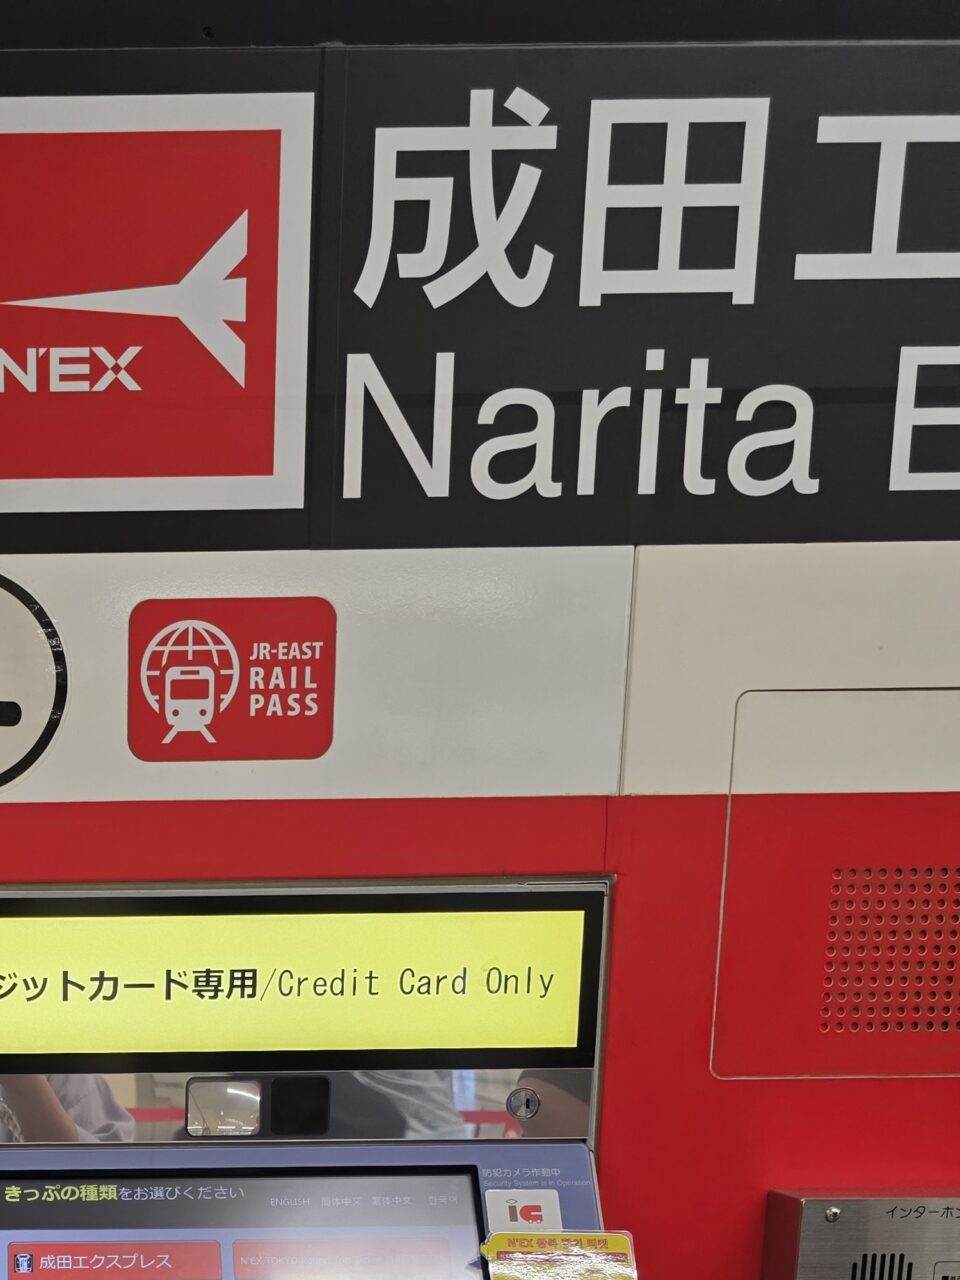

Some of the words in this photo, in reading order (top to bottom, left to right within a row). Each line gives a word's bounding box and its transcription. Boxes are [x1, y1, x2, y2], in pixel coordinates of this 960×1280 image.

[343, 346, 819, 500] Narita
[249, 641, 324, 660] JR-EAST
[249, 666, 318, 690] RAIL
[249, 693, 319, 717] PASS
[399, 967, 468, 998] Card
[486, 967, 554, 1000] Only
[4, 1184, 245, 1202] きっぷの種類をお選びください
[39, 1254, 173, 1270] 成田エクスプレス
[240, 1256, 263, 1265] N'EX
[264, 1256, 298, 1265] TOKYO
